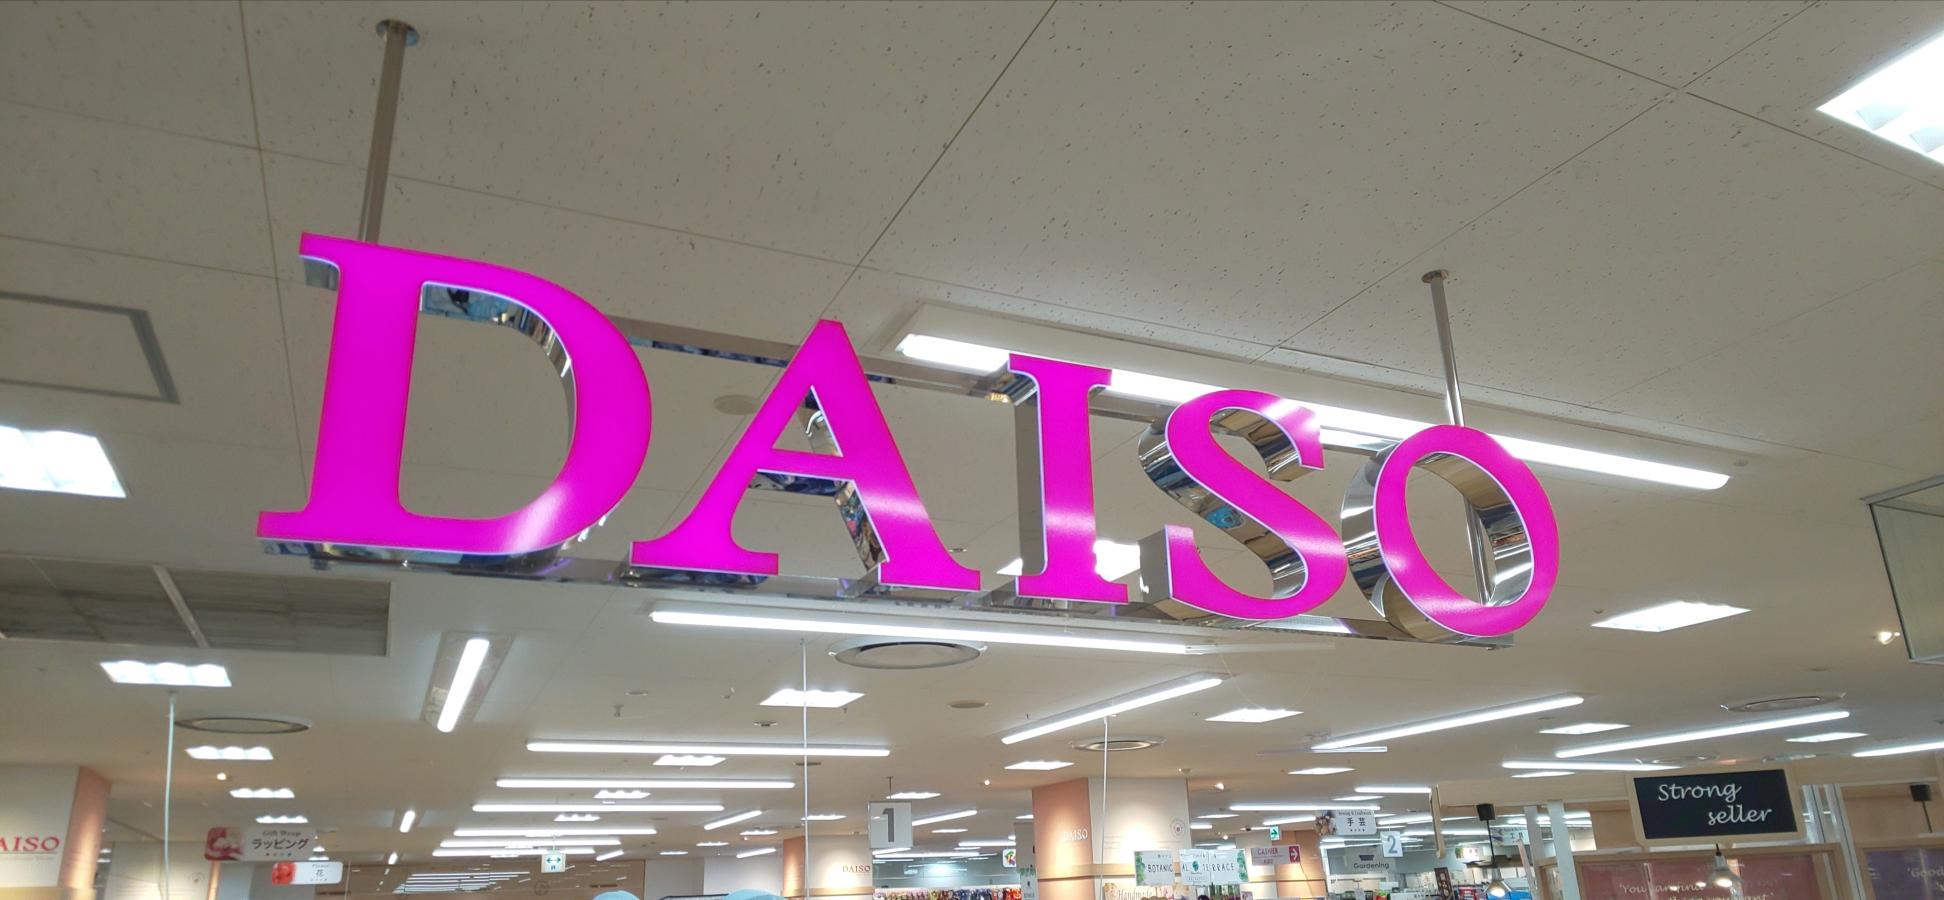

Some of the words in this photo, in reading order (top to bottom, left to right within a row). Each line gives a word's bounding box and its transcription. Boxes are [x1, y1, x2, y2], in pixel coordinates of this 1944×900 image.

[257, 233, 1560, 638] DAISO
[1658, 783, 1742, 802] Strong
[1347, 818, 1366, 827] 手芸
[1708, 804, 1773, 825] seller
[882, 808, 895, 842] 1
[252, 839, 309, 849] ラッピング
[1387, 835, 1398, 854] 2
[842, 864, 871, 873] DAISO
[1353, 862, 1390, 870] Gardening
